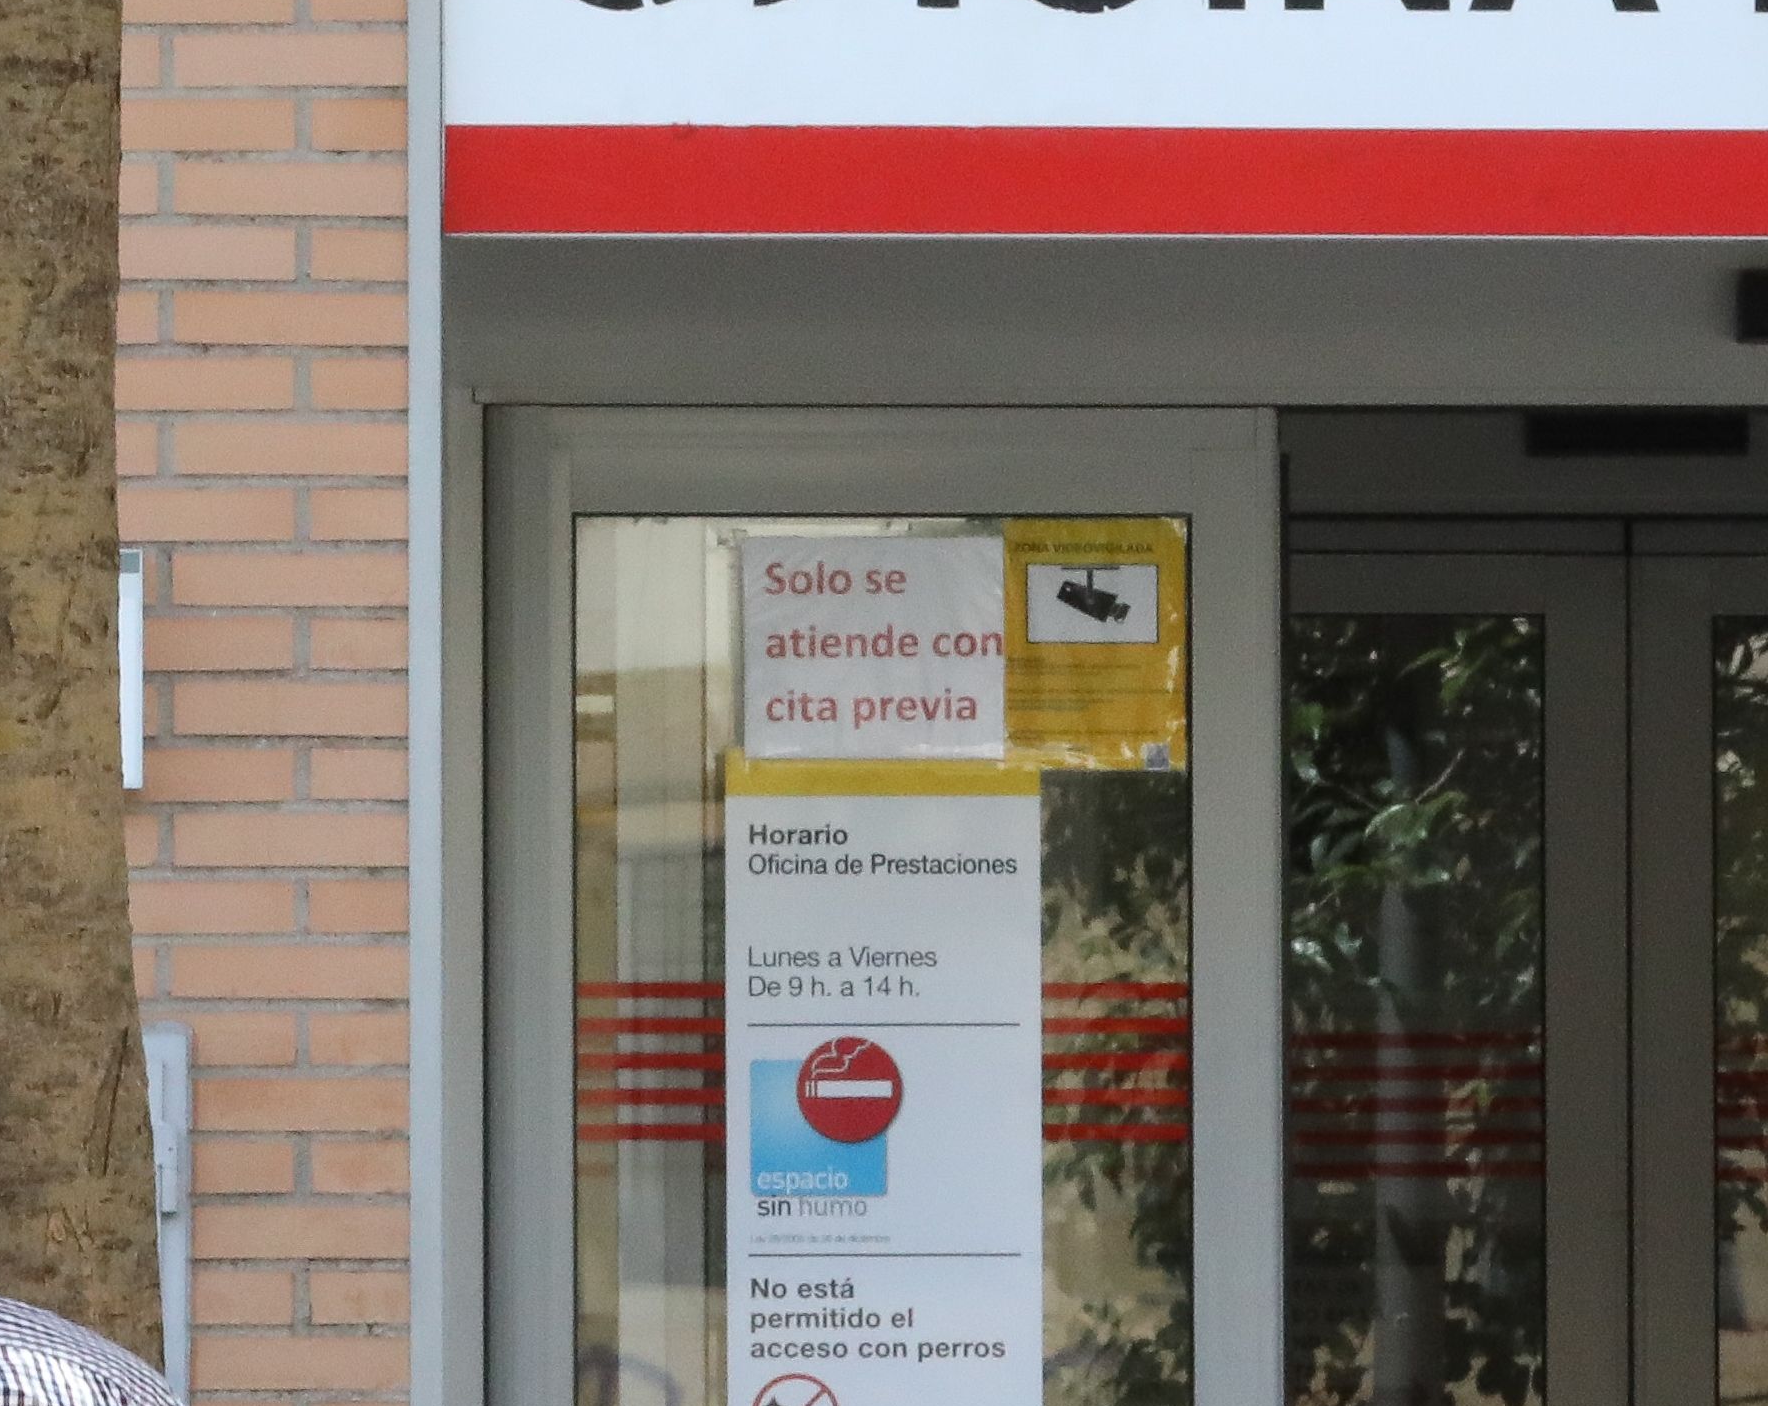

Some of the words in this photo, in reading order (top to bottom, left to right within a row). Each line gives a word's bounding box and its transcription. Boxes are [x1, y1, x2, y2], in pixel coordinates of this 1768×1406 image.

[763, 560, 854, 596] Solo
[865, 568, 908, 595] se
[765, 623, 920, 659] atiende
[932, 630, 1004, 658] con
[765, 688, 839, 723] cita
[852, 687, 978, 731] previa
[748, 823, 849, 846] Horario
[748, 853, 828, 875] Oficina
[834, 853, 864, 875] de
[870, 853, 1019, 876] Prestaciones
[747, 945, 821, 968] Lunes
[827, 950, 843, 968] a
[849, 945, 938, 968] Viernes
[747, 975, 782, 997] De
[788, 976, 803, 997] 9
[810, 975, 833, 997] h.
[840, 979, 855, 997] a
[863, 976, 892, 997] 14
[899, 975, 921, 997] h.
[757, 1166, 850, 1195] espacio
[757, 1194, 792, 1217] sin
[798, 1196, 868, 1217] humo
[750, 1277, 788, 1300] No
[796, 1277, 855, 1300] está
[750, 1307, 881, 1334] permitido
[890, 1307, 914, 1329] el
[750, 1341, 849, 1359] acceso
[857, 1341, 908, 1359] con
[917, 1341, 1006, 1363] perros
